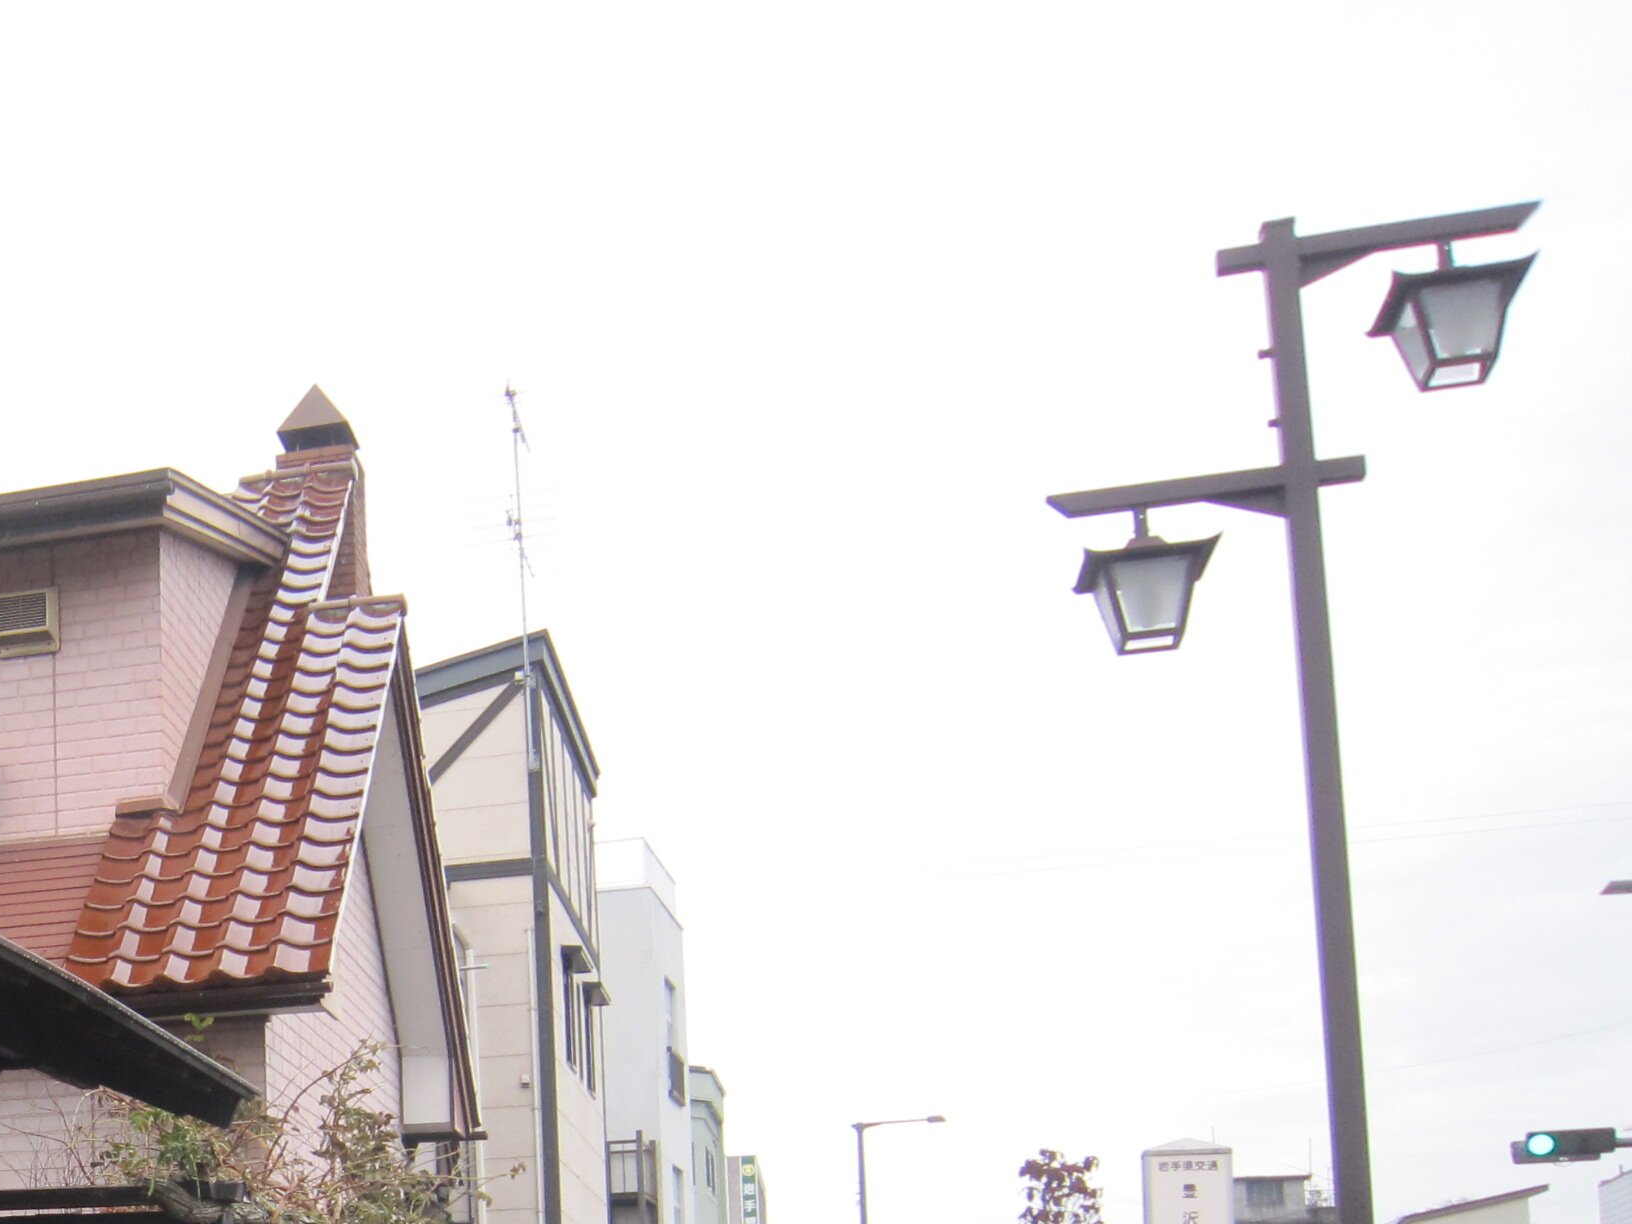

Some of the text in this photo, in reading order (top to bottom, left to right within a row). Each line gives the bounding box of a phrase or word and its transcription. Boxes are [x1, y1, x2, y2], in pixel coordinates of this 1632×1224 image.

[1159, 1160, 1218, 1172] 岩手県交通
